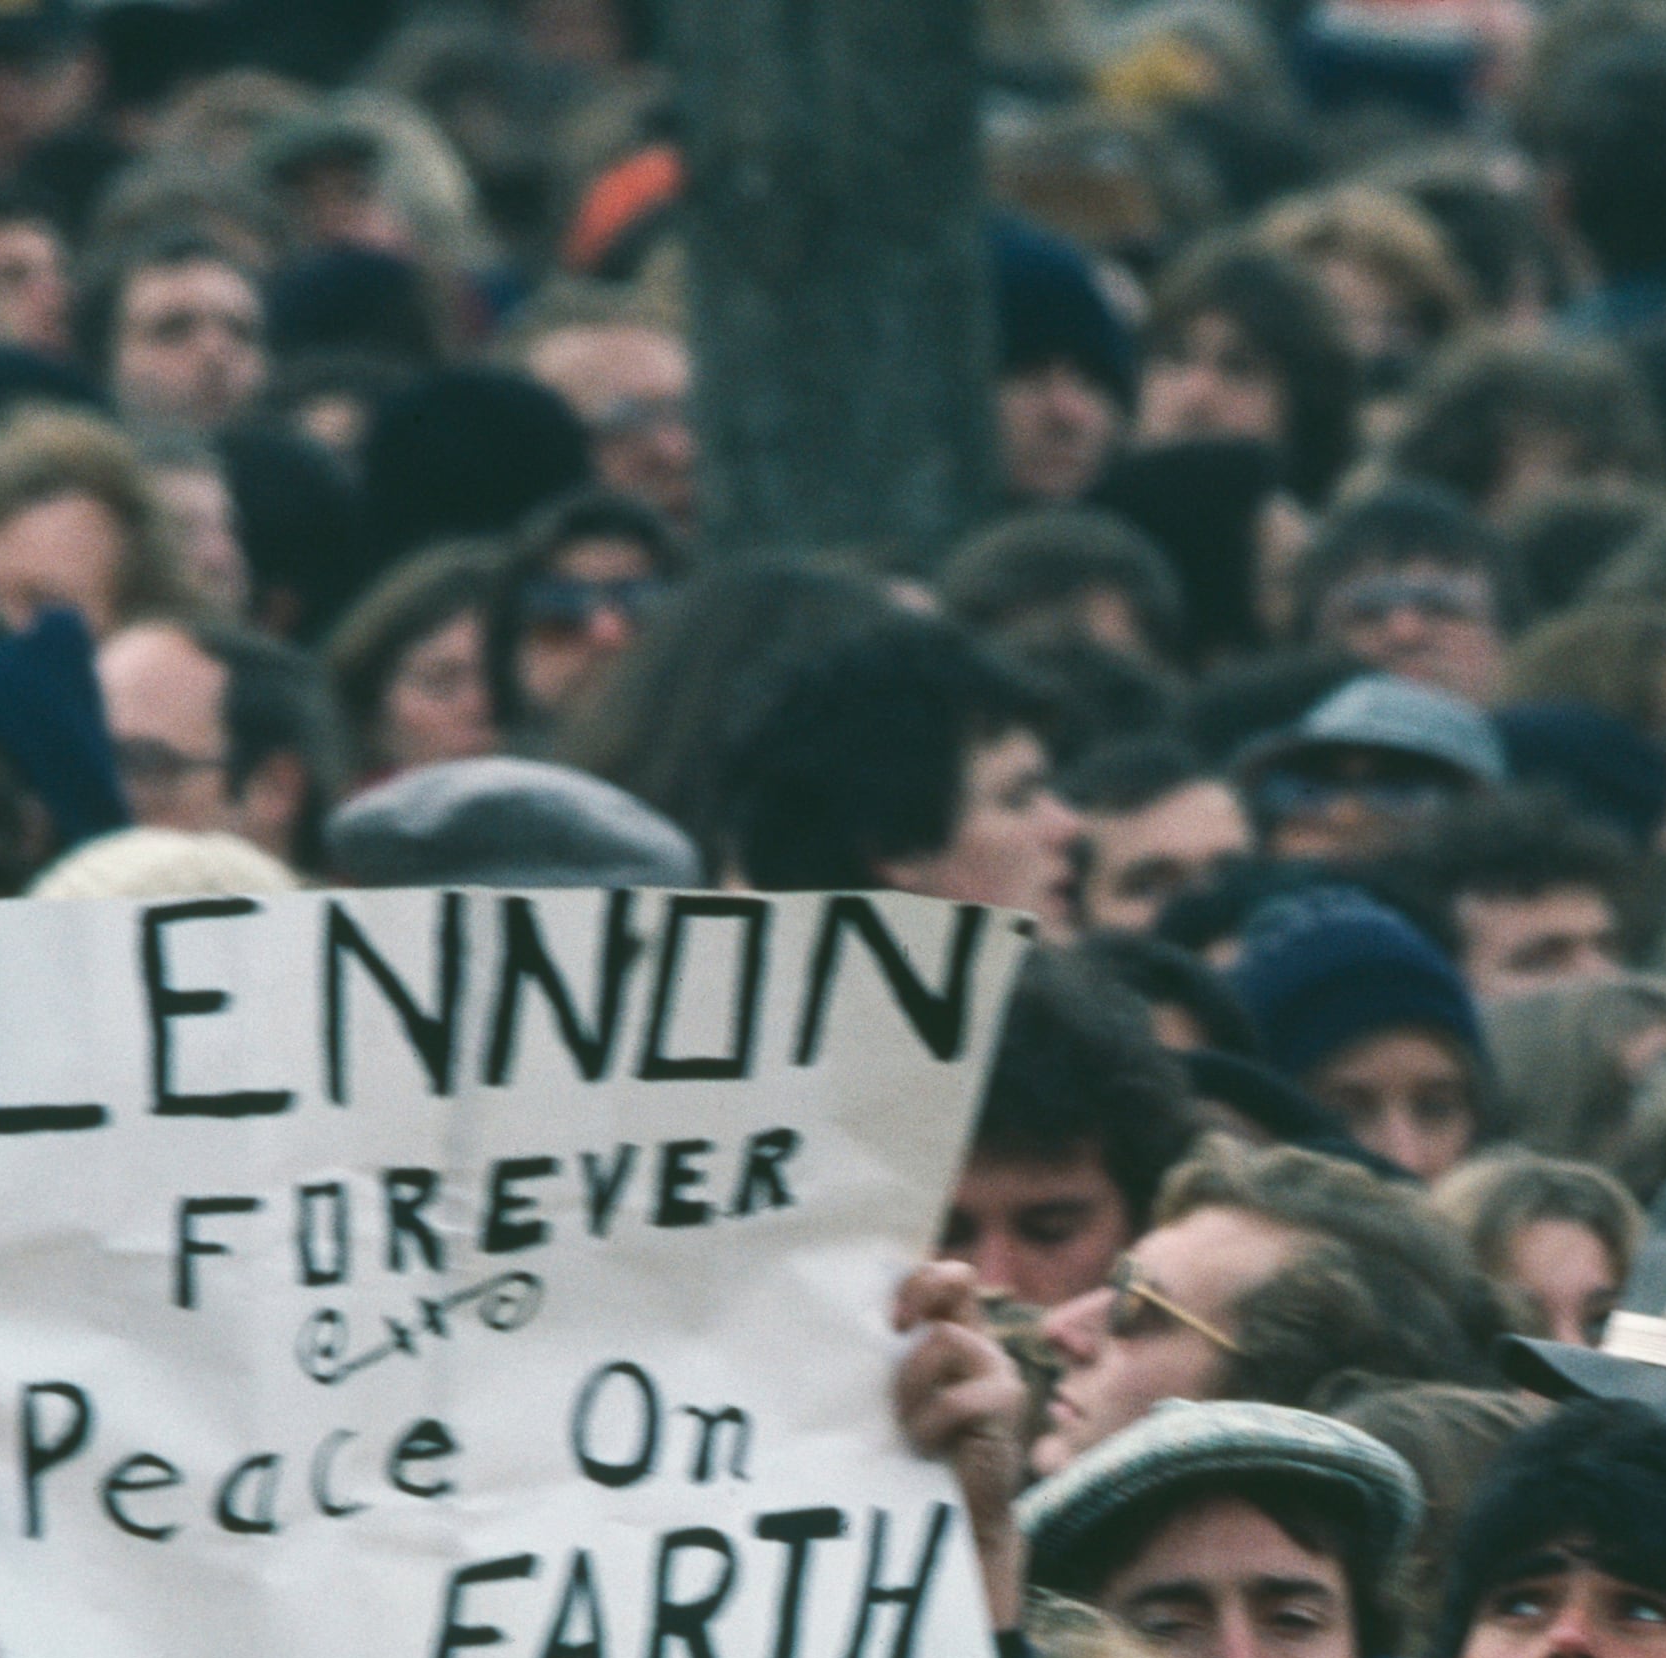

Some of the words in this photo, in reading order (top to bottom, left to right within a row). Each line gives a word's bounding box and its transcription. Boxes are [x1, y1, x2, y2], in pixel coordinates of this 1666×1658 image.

[174, 1128, 803, 1310] FOREVER
[19, 1381, 460, 1542] Peace
[571, 1362, 755, 1489] On
